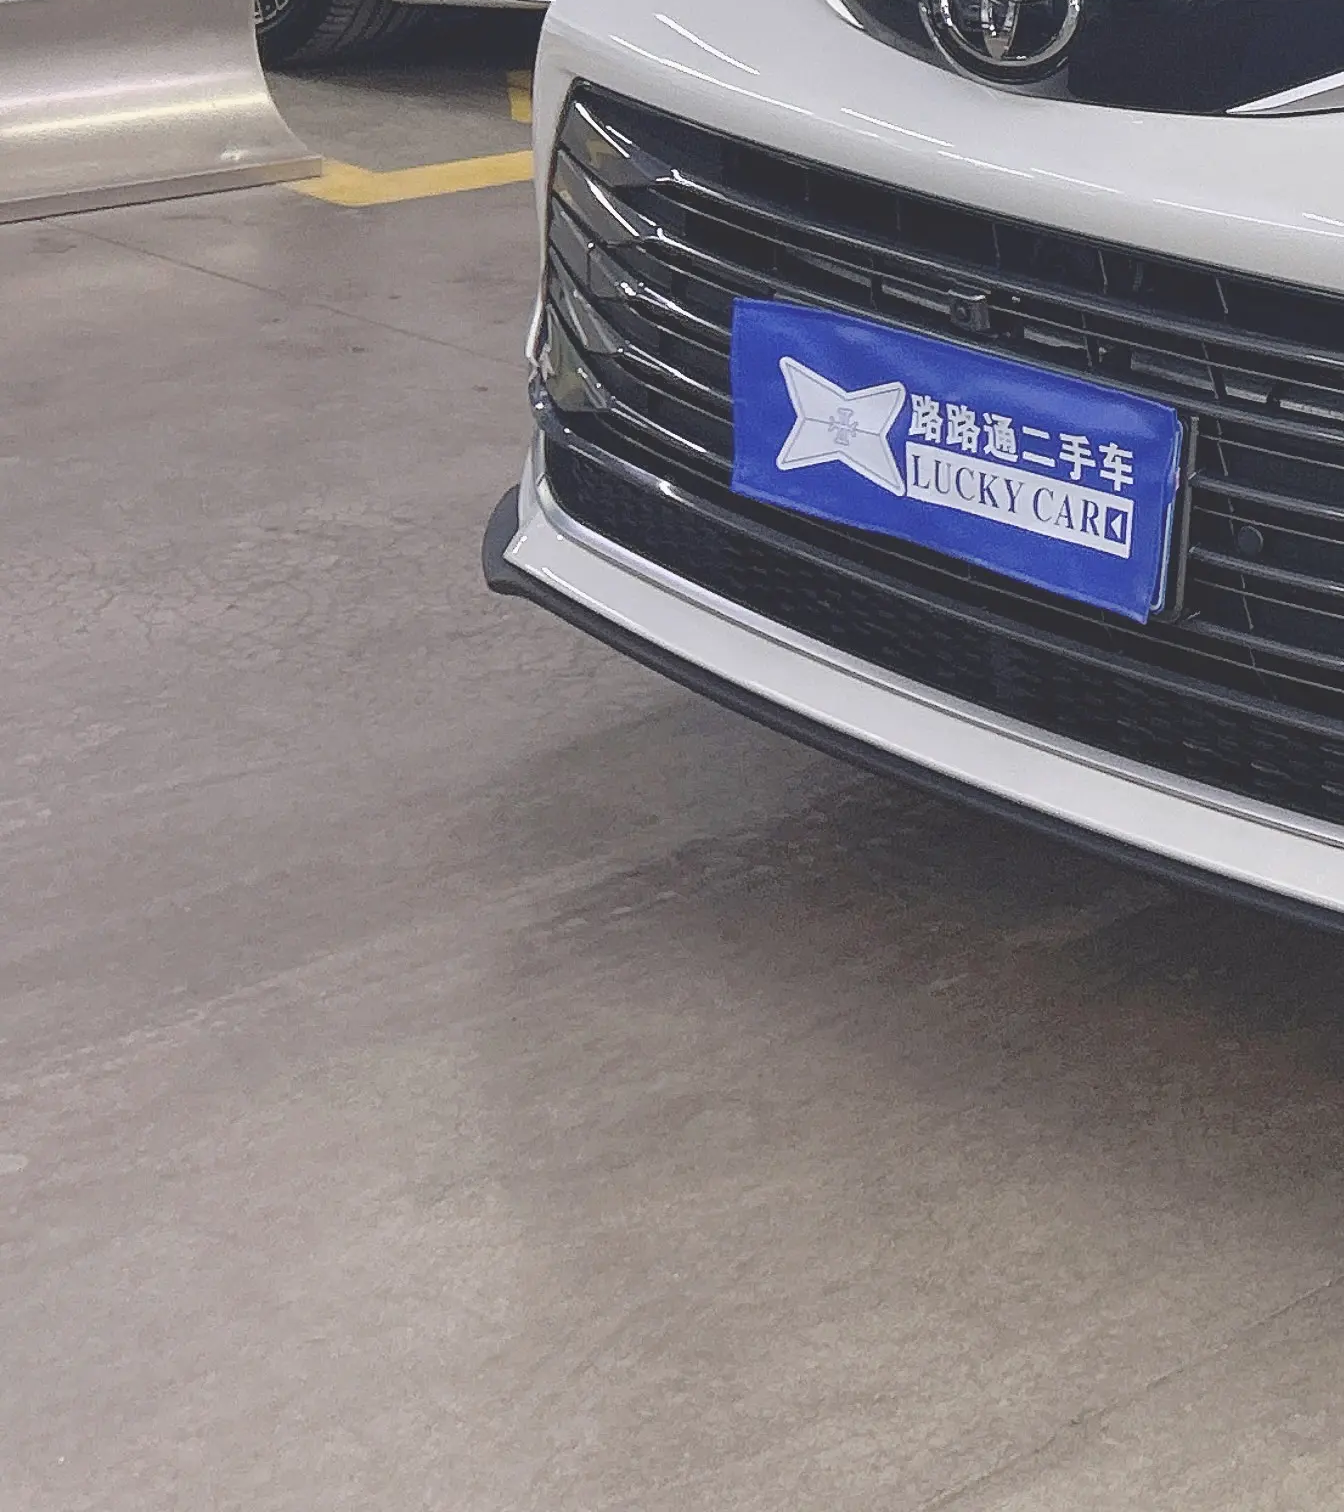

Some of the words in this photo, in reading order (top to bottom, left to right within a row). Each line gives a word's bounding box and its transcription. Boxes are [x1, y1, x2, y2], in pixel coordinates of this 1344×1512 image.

[909, 393, 1135, 492] 路路通二手车
[911, 454, 1024, 514] LUCKY
[1032, 487, 1101, 537] CAR
